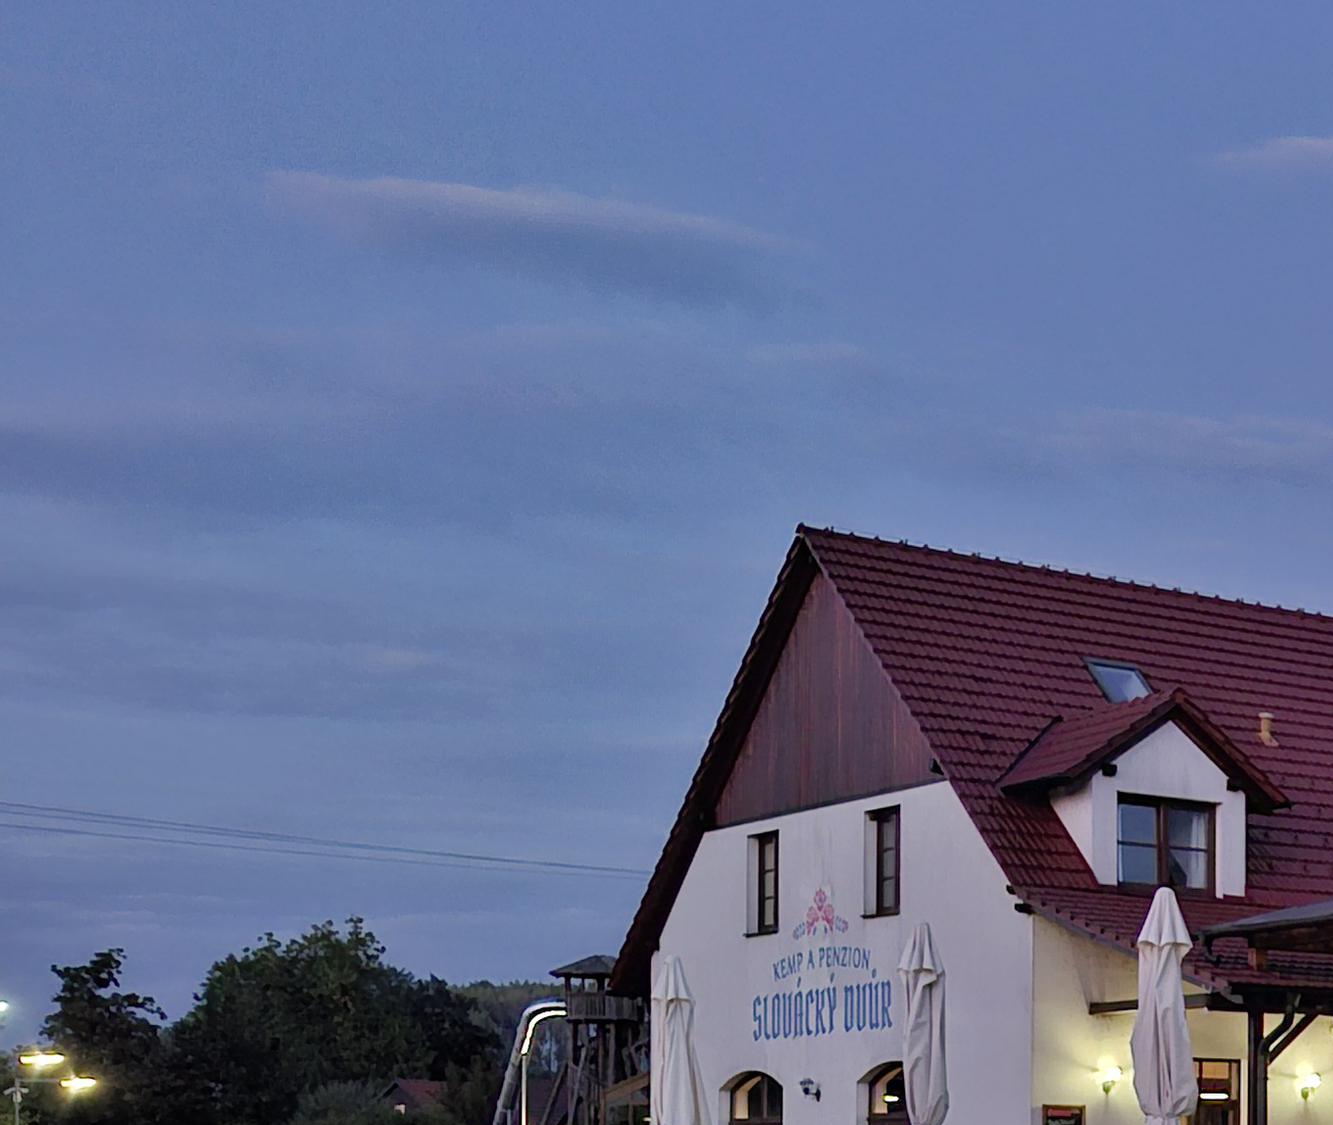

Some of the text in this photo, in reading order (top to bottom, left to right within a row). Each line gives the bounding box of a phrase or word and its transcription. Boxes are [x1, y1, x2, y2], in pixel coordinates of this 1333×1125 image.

[772, 946, 871, 982] KEMP A PENZION
